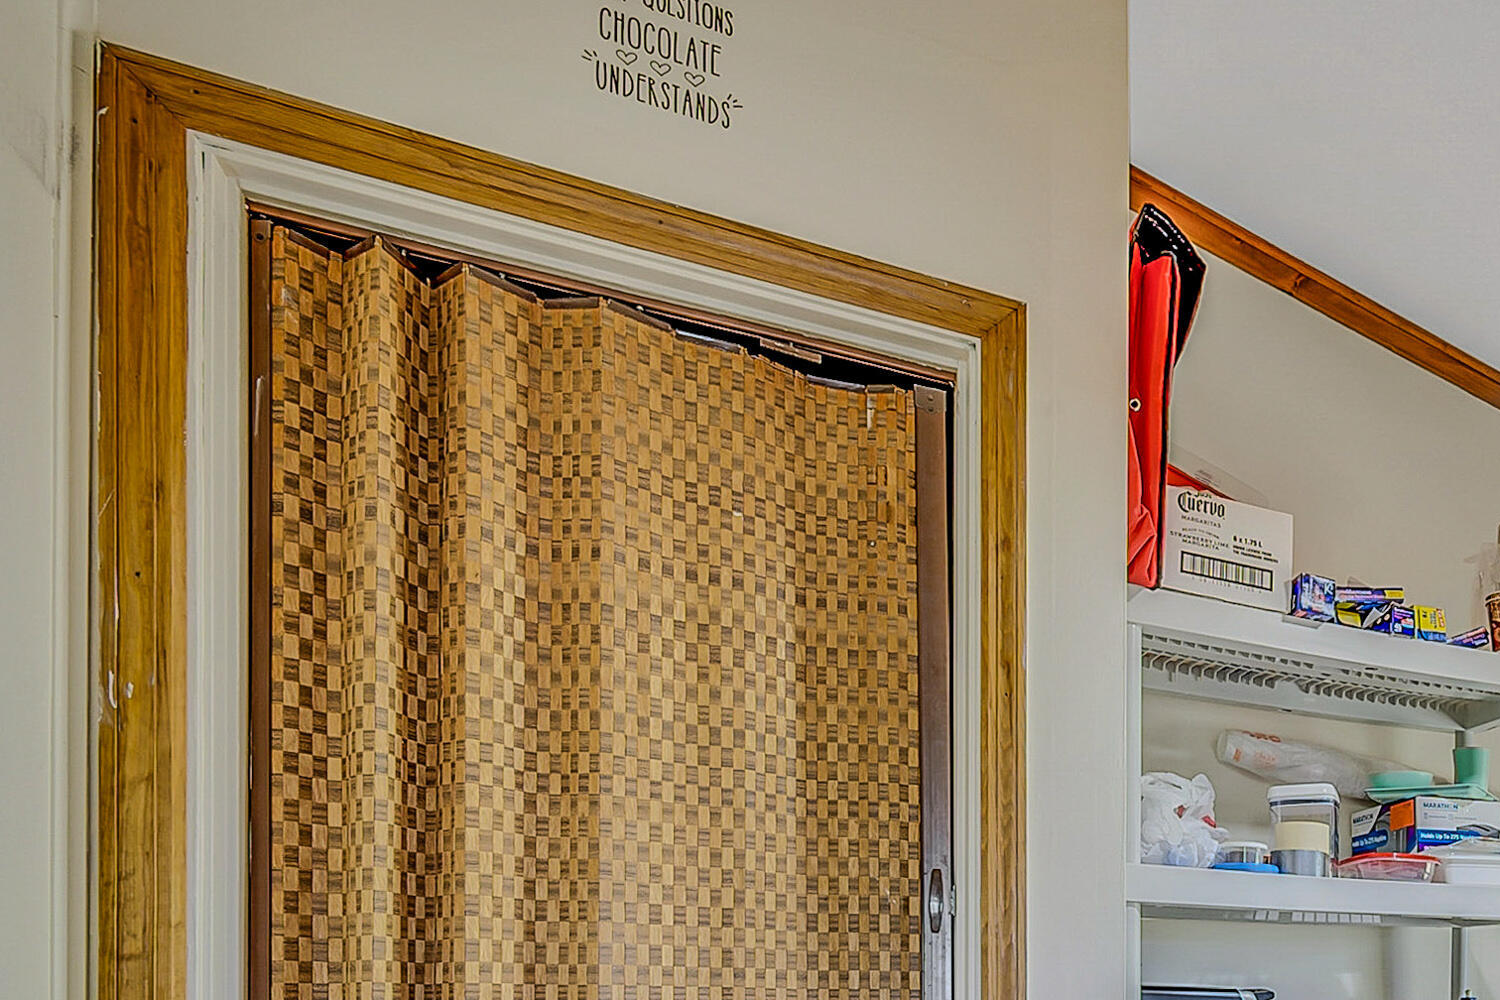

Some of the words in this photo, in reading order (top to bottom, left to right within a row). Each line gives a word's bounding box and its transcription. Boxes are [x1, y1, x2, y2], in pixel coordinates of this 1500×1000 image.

[599, 7, 722, 77] CHOCOLATE
[595, 59, 731, 129] UNDERSTANDS
[1177, 491, 1225, 518] Cuervo
[1181, 515, 1221, 529] MARGARITAS
